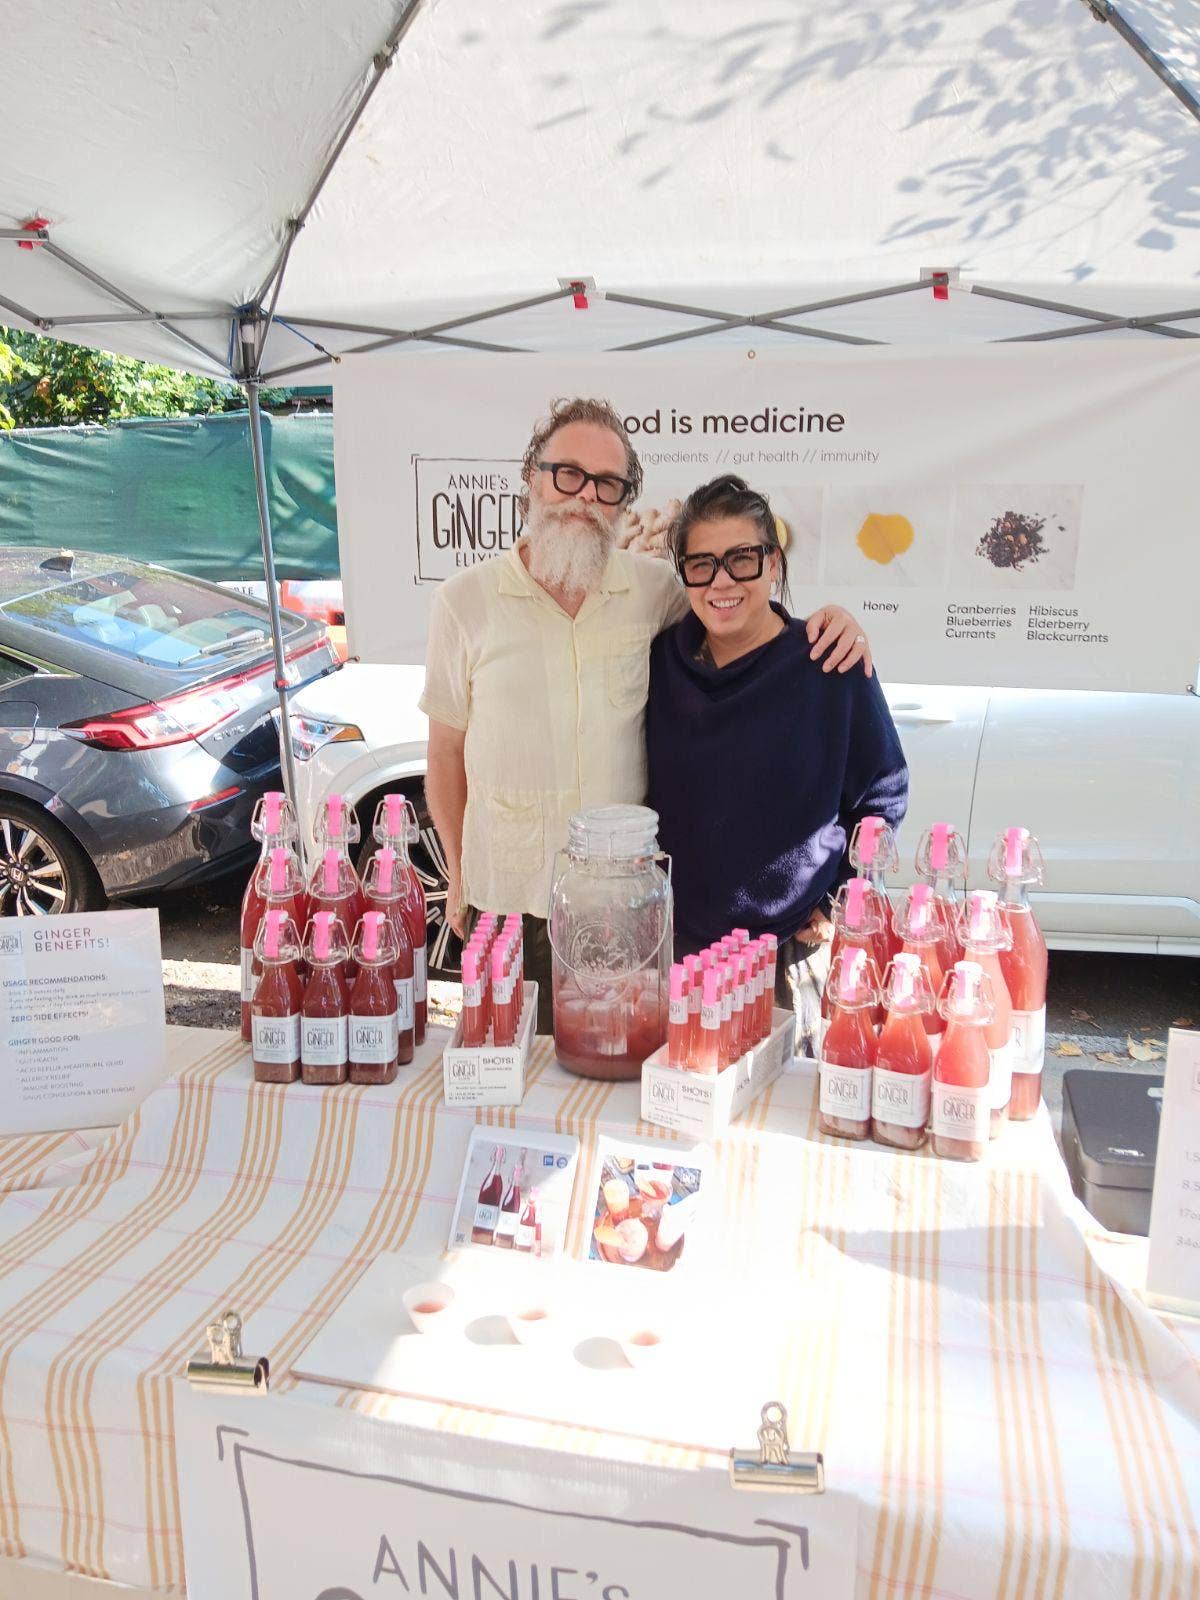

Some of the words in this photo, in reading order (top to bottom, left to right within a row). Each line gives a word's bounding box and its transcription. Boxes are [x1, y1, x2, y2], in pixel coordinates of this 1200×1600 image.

[623, 408, 661, 434] od
[671, 408, 693, 434] is
[702, 406, 846, 434] medicine
[640, 449, 710, 466] ingredients
[732, 451, 756, 466] gut
[758, 449, 800, 462] health
[820, 448, 880, 465] immunity
[862, 599, 900, 614] Honey
[946, 603, 1017, 616] Cranberries
[1028, 604, 1079, 617] Hibiscus
[945, 615, 1013, 628] Blueberries
[1027, 617, 1090, 632] Elderberry
[944, 627, 997, 640] Currants
[1026, 629, 1110, 643] Blackcurrants
[33, 927, 92, 940] GINGER
[34, 937, 110, 952] BENEFITS!
[2, 978, 28, 988] USAGE
[10, 1014, 33, 1023] ZERO
[34, 1012, 52, 1021] SIDE
[39, 1035, 62, 1044] GOOD
